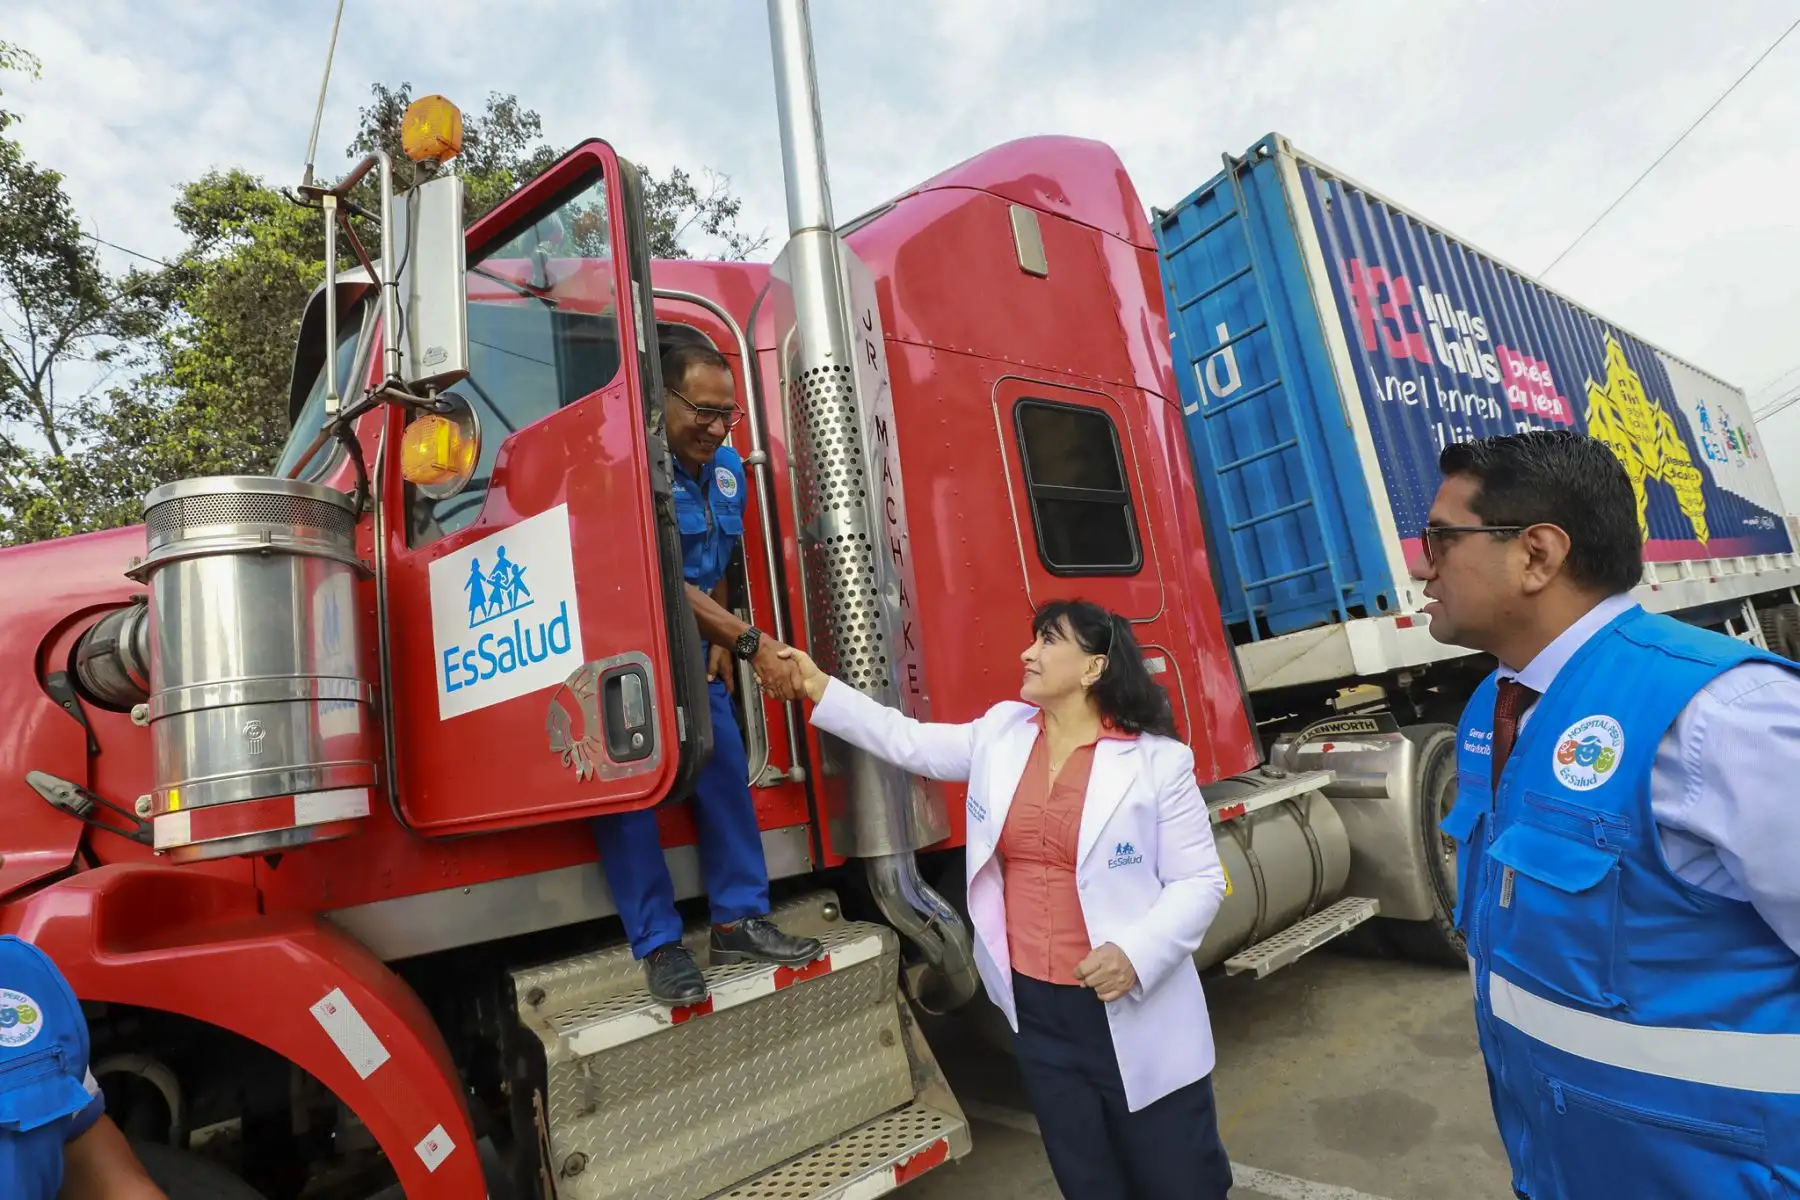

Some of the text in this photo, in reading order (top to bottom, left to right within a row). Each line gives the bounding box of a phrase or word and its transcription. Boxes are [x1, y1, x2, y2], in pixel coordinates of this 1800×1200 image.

[443, 600, 572, 693] EsSalud
[1306, 720, 1376, 738] KENWORTH
[1567, 719, 1609, 739] HOSPITAL
[1559, 767, 1598, 787] EsSalud
[1107, 854, 1143, 870] EsSalud
